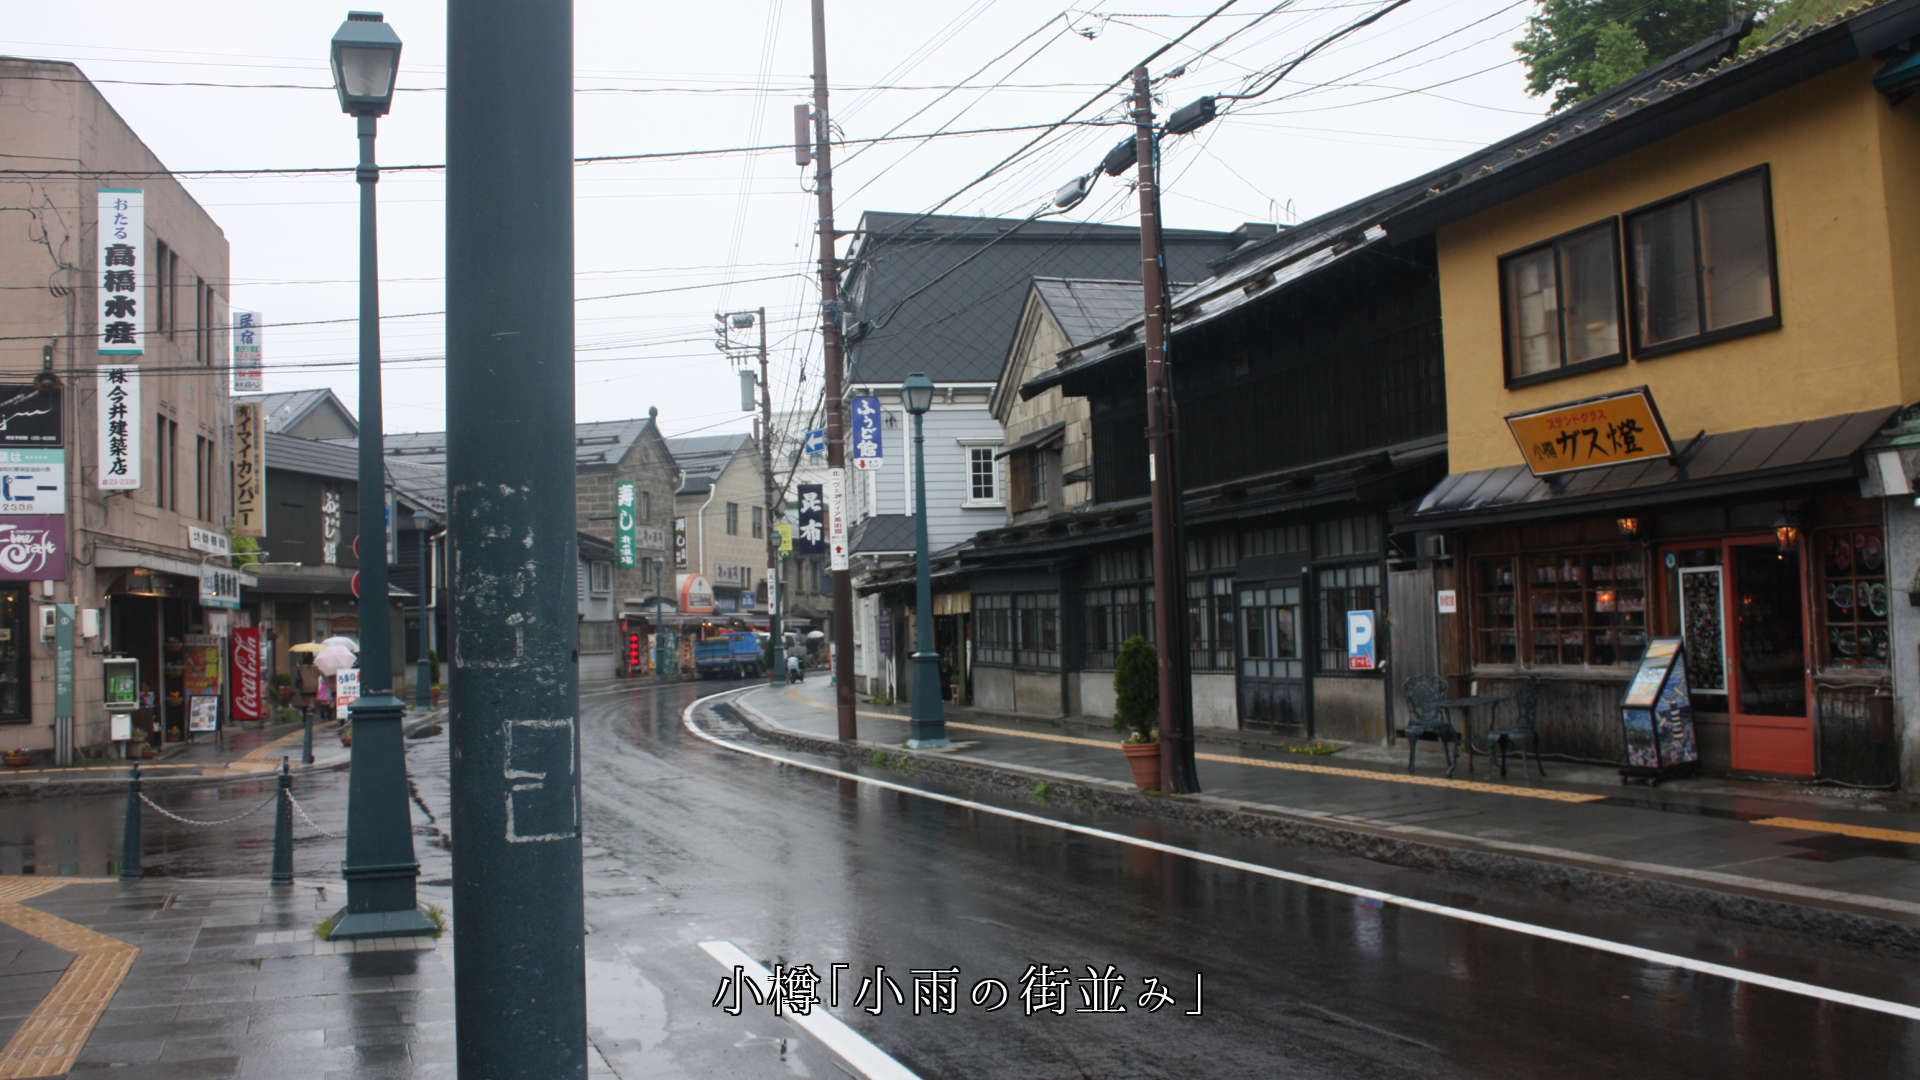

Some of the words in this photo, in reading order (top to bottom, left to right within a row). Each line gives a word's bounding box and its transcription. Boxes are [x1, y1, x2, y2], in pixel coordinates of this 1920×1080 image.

[113, 198, 128, 239] おたる
[104, 243, 136, 344] 高橋水産
[240, 313, 255, 344] 民宿
[1533, 441, 1557, 460] 小樽
[618, 484, 634, 531] 寿し
[800, 491, 823, 546] 昆布
[1350, 614, 1372, 654] P
